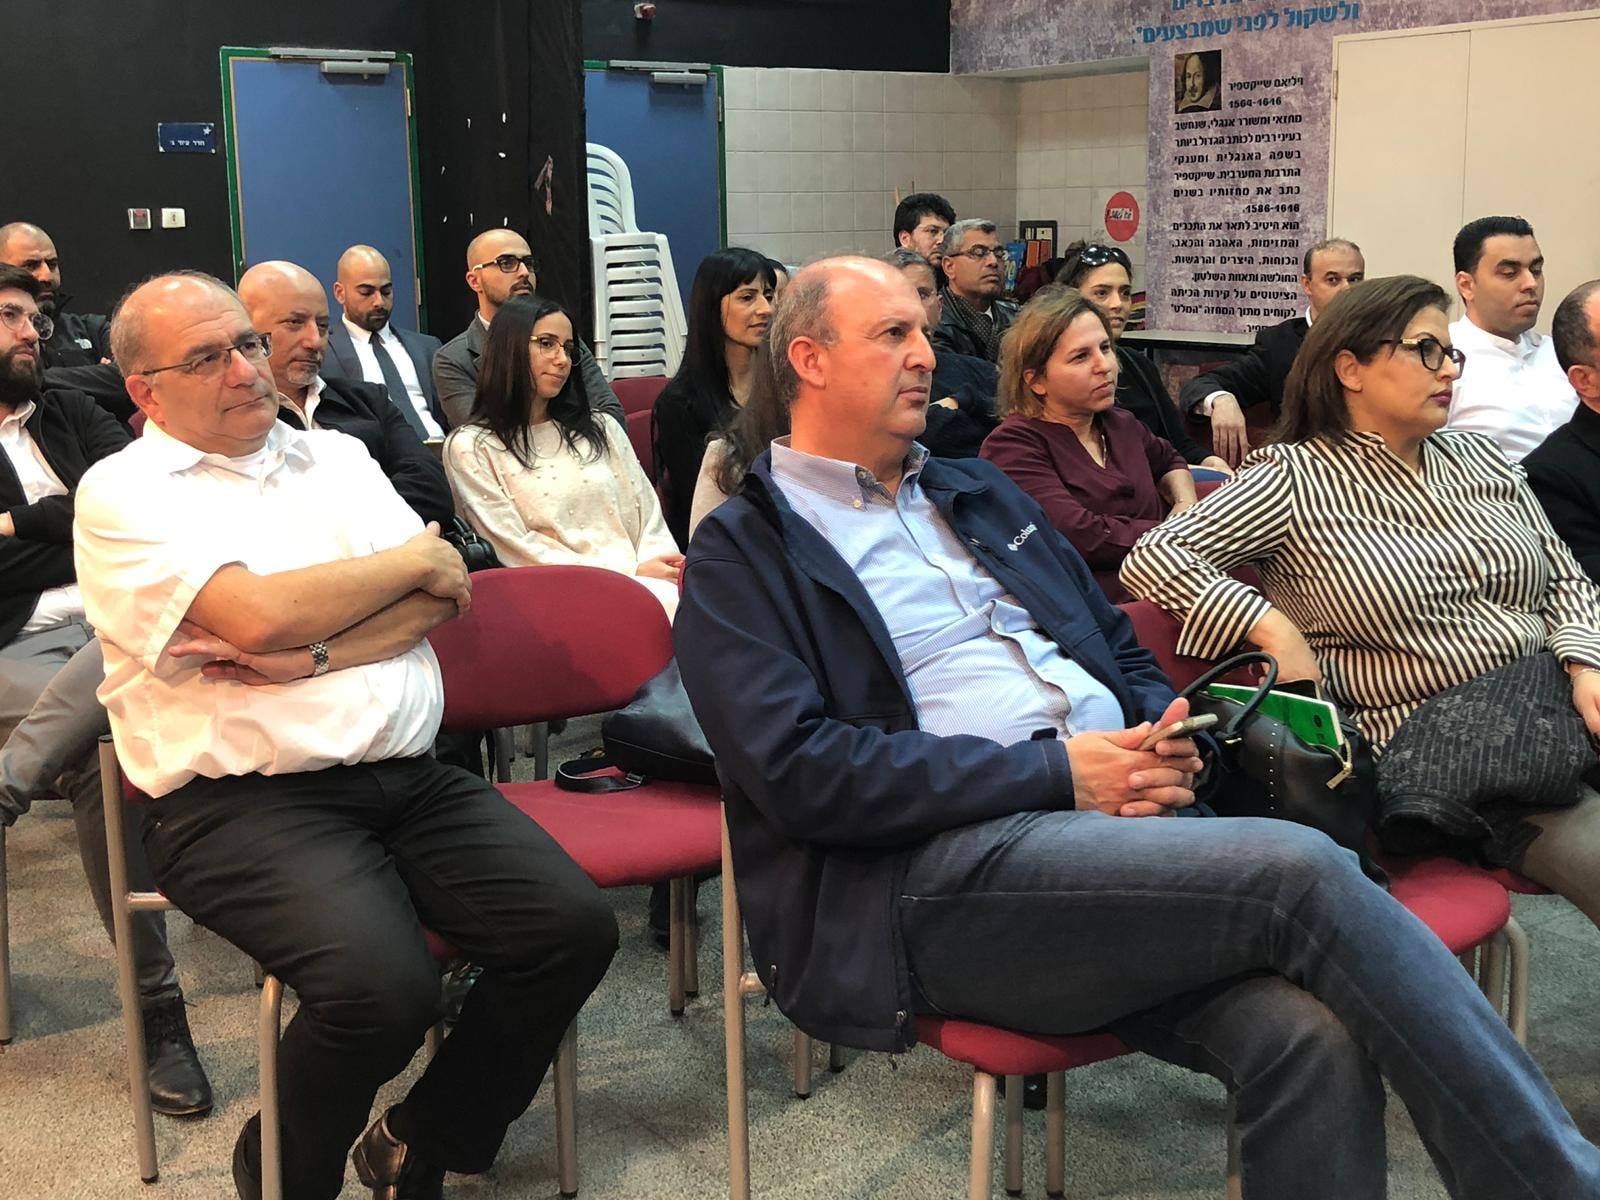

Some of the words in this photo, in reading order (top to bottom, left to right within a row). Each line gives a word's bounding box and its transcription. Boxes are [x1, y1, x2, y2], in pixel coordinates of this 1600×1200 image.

[1284, 1, 1360, 29] ולשקול
[1237, 9, 1279, 32] לפני
[1228, 79, 1271, 91] שייקספיר
[1274, 76, 1303, 88] ויליאם
[1228, 97, 1282, 108] 1564-1616
[1208, 118, 1235, 129] אנגלי,
[1239, 116, 1270, 126] ומשורר
[1272, 114, 1303, 124] מחזאי
[1175, 120, 1206, 130] שנחשב
[1199, 135, 1225, 146] הגדול
[1227, 133, 1254, 144] לכותב
[1255, 133, 1276, 142] רבים
[1277, 132, 1302, 141] בעיני
[1175, 138, 1198, 147] ביותר
[1174, 154, 1209, 165] ומענקי
[1216, 152, 1261, 162] האנגלית
[1269, 150, 1301, 160] בשפה
[1174, 171, 1215, 181] שייקספיר
[1217, 169, 1261, 179] המערבית.
[1264, 168, 1301, 178] התרבות
[1173, 188, 1204, 197] בשנים
[1209, 187, 1250, 197] מחזותיו
[1256, 186, 1272, 195] את
[1279, 186, 1301, 195] כתב
[1173, 222, 1206, 231] התככים
[1208, 221, 1223, 230] את
[1225, 220, 1251, 230] לתאר
[1253, 221, 1279, 230] היטיב
[1281, 221, 1300, 230] הוא
[1208, 239, 1243, 248] האהבה
[1220, 256, 1254, 265] היצרים
[1228, 273, 1258, 282] ותאוות
[1260, 272, 1298, 283] החולשה
[1171, 288, 1200, 298] הכיתה
[1203, 289, 1230, 300] קירות
[1233, 289, 1247, 299] על
[1250, 291, 1297, 300] הציטוטים
[1204, 305, 1235, 315] המחזה
[1237, 307, 1260, 317] מתוך
[1263, 307, 1297, 319] לקוחים
